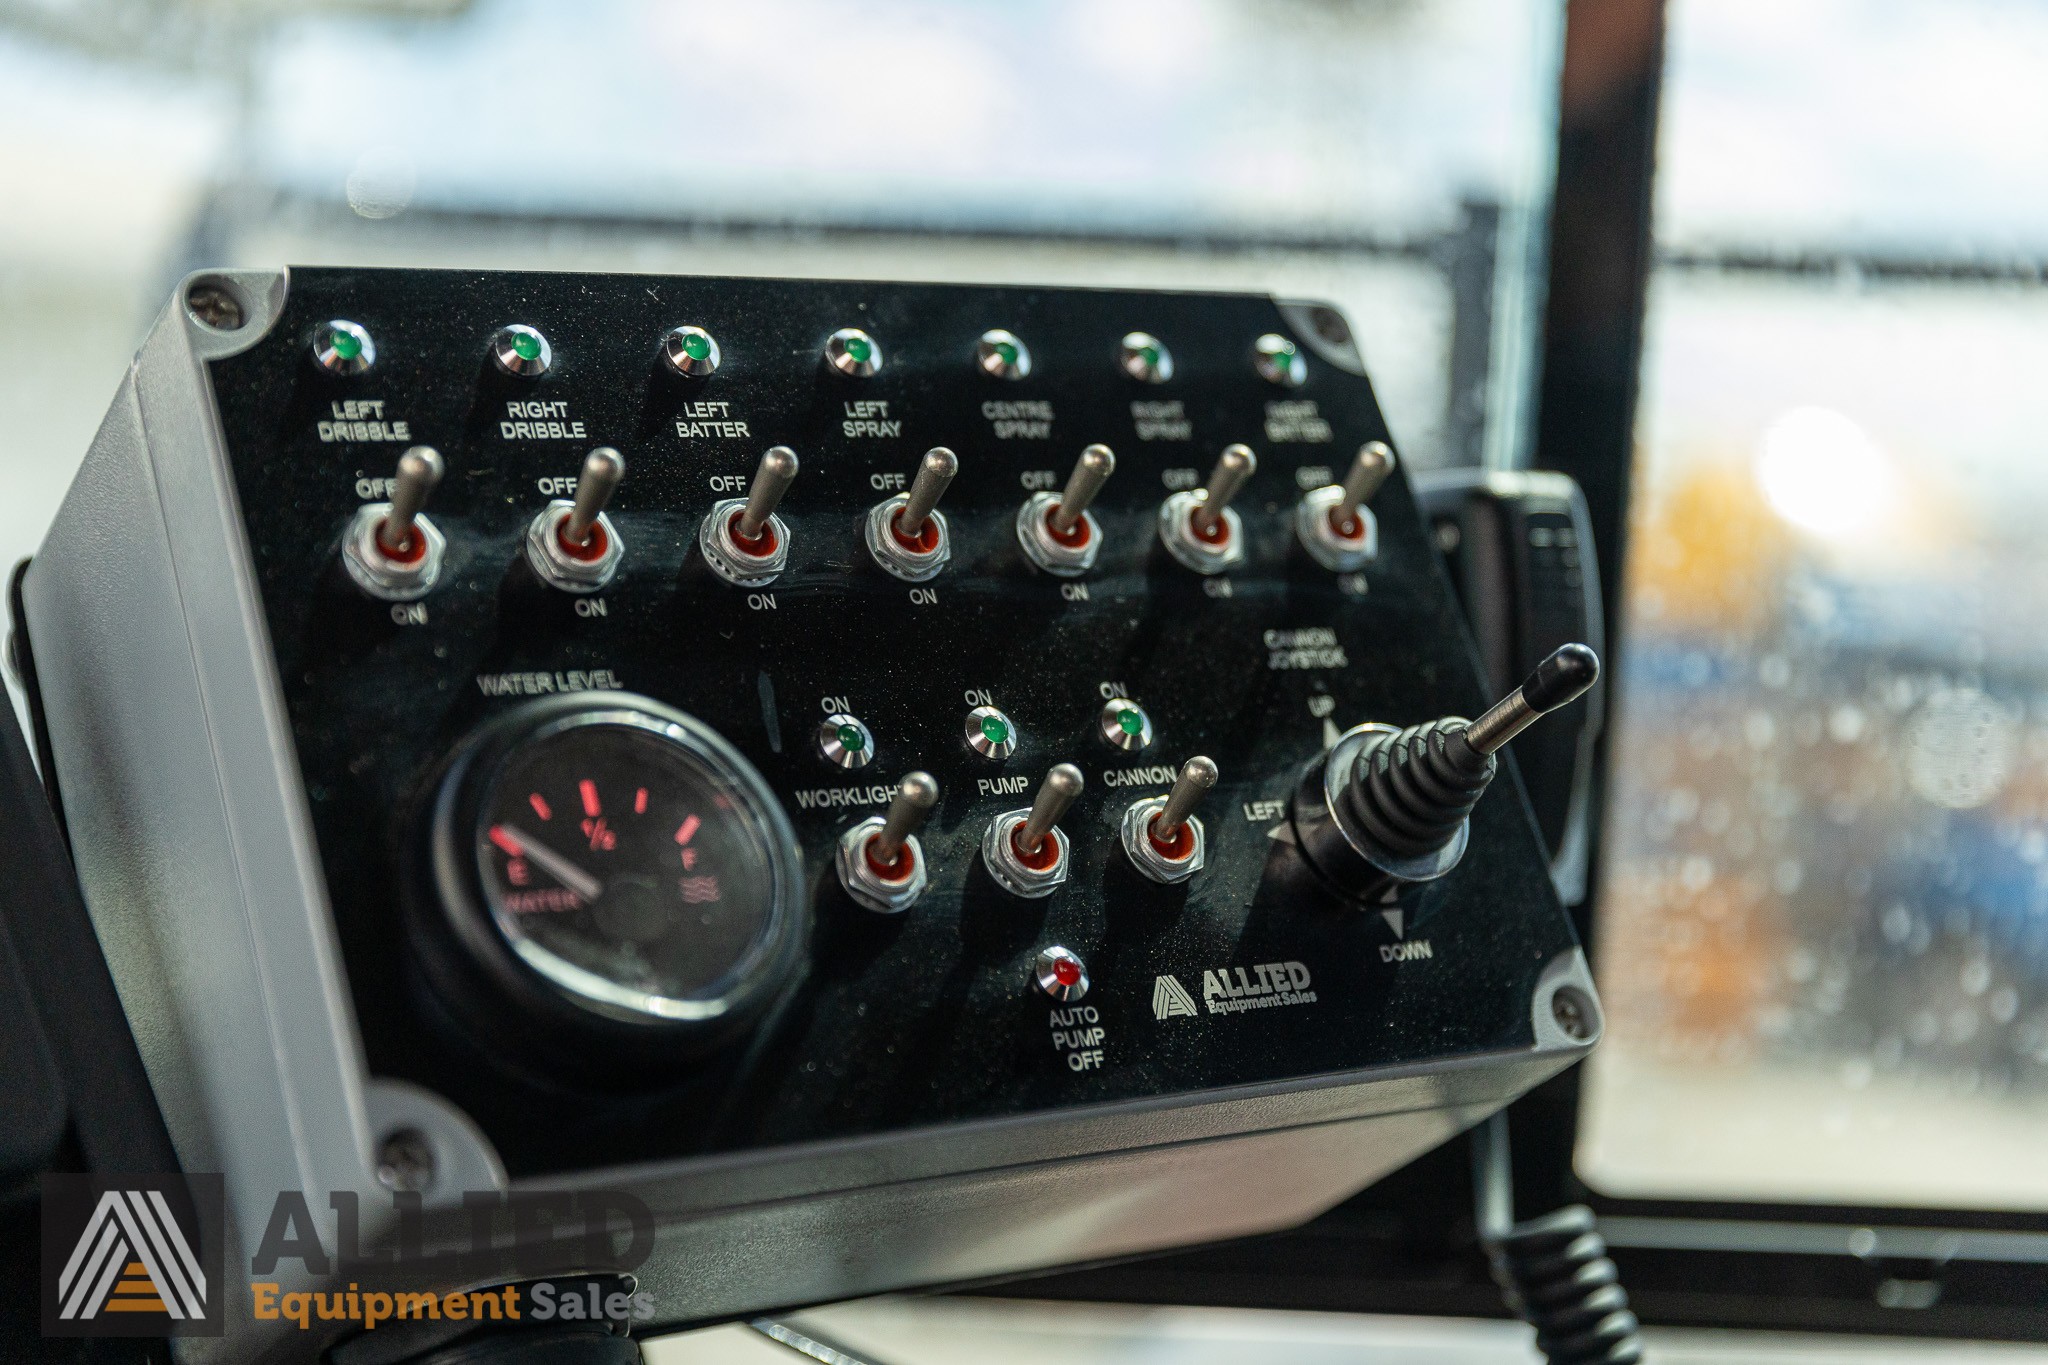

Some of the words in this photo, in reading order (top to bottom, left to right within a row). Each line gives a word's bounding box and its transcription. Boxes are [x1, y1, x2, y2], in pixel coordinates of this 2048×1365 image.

[332, 402, 385, 420] LEFT
[507, 402, 568, 419] RIGHT
[684, 402, 729, 419] LEFT
[844, 401, 888, 419] LEFT
[981, 401, 1054, 421] CENTRE
[318, 420, 411, 442] DRIBBLE
[500, 421, 587, 440] DRIBBLE
[676, 422, 750, 439] BATTER
[843, 420, 900, 438] SPRAY
[994, 420, 1051, 440] SPRAY
[355, 477, 396, 499] OFF
[538, 477, 577, 495] OFF
[709, 475, 746, 492] OFF
[870, 473, 905, 491] OFF
[1020, 471, 1055, 489] OFF
[909, 588, 938, 605] ON
[1060, 583, 1089, 602] ON
[574, 600, 608, 618] ON
[748, 595, 777, 612] ON
[390, 602, 428, 625] ON
[477, 673, 553, 696] WATER
[555, 670, 622, 690] LEVEL
[1100, 681, 1127, 700] ON
[821, 696, 850, 714] ON
[964, 689, 992, 706] ON
[978, 777, 1029, 796] PUMP
[1103, 766, 1178, 788] CANNON
[795, 784, 902, 809] WORKLIGH
[1242, 799, 1284, 821] LEFT
[1379, 940, 1434, 962] DOWN
[1203, 961, 1312, 1000] ALLIED
[1205, 996, 1283, 1015] Equipment
[1282, 990, 1318, 1006] Sales
[1050, 1006, 1099, 1028] AUTO
[1052, 1027, 1105, 1051] PUMP
[1067, 1050, 1104, 1072] OFF
